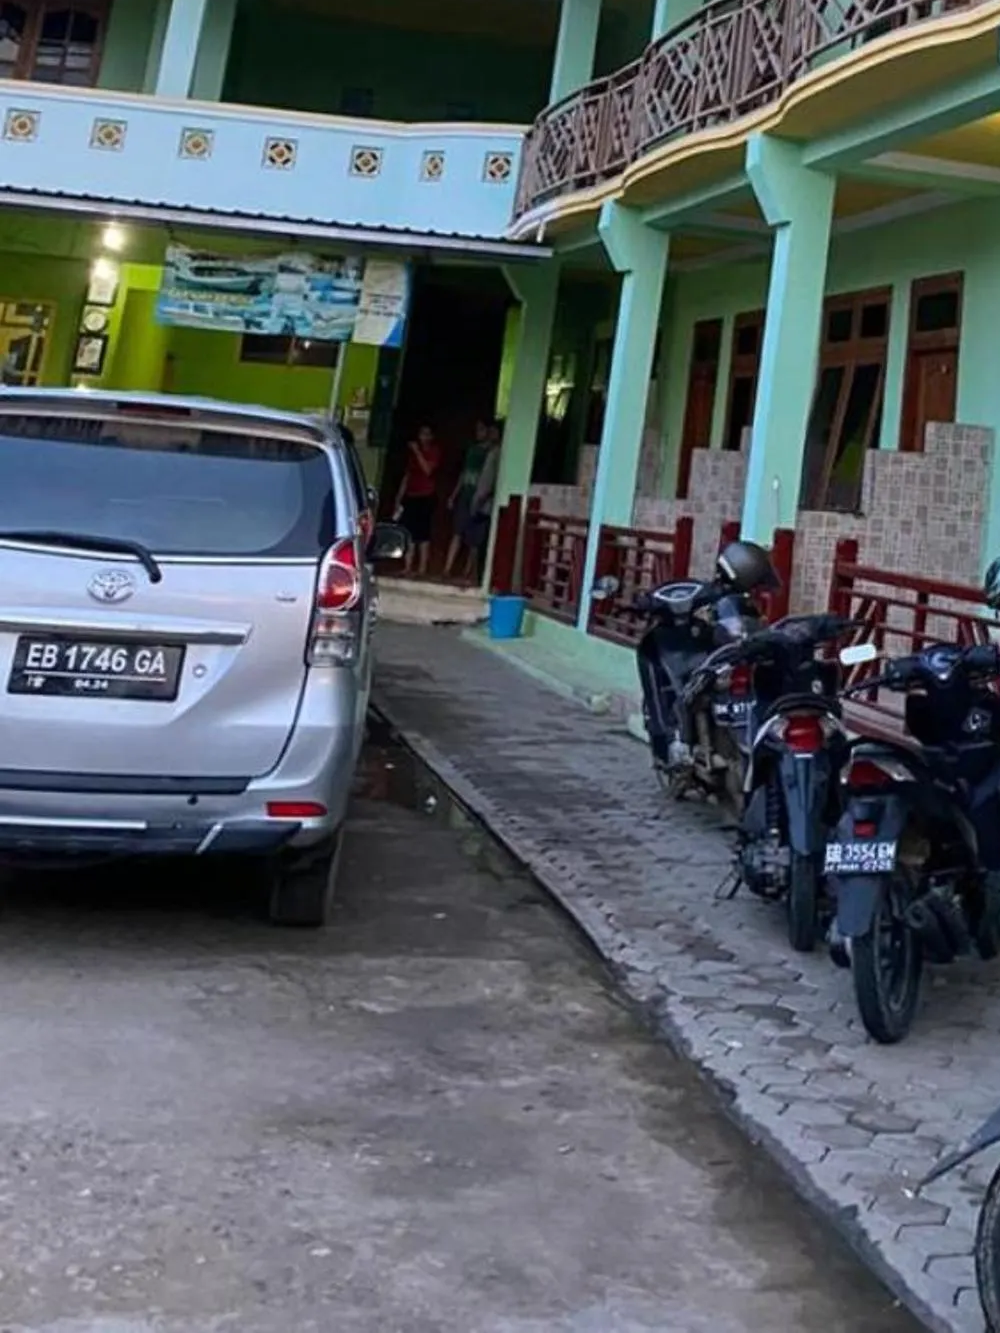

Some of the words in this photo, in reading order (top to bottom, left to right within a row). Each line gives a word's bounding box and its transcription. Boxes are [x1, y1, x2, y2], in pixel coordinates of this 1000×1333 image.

[25, 643, 59, 669] EB
[64, 645, 129, 673] 1746
[133, 649, 166, 675] GA
